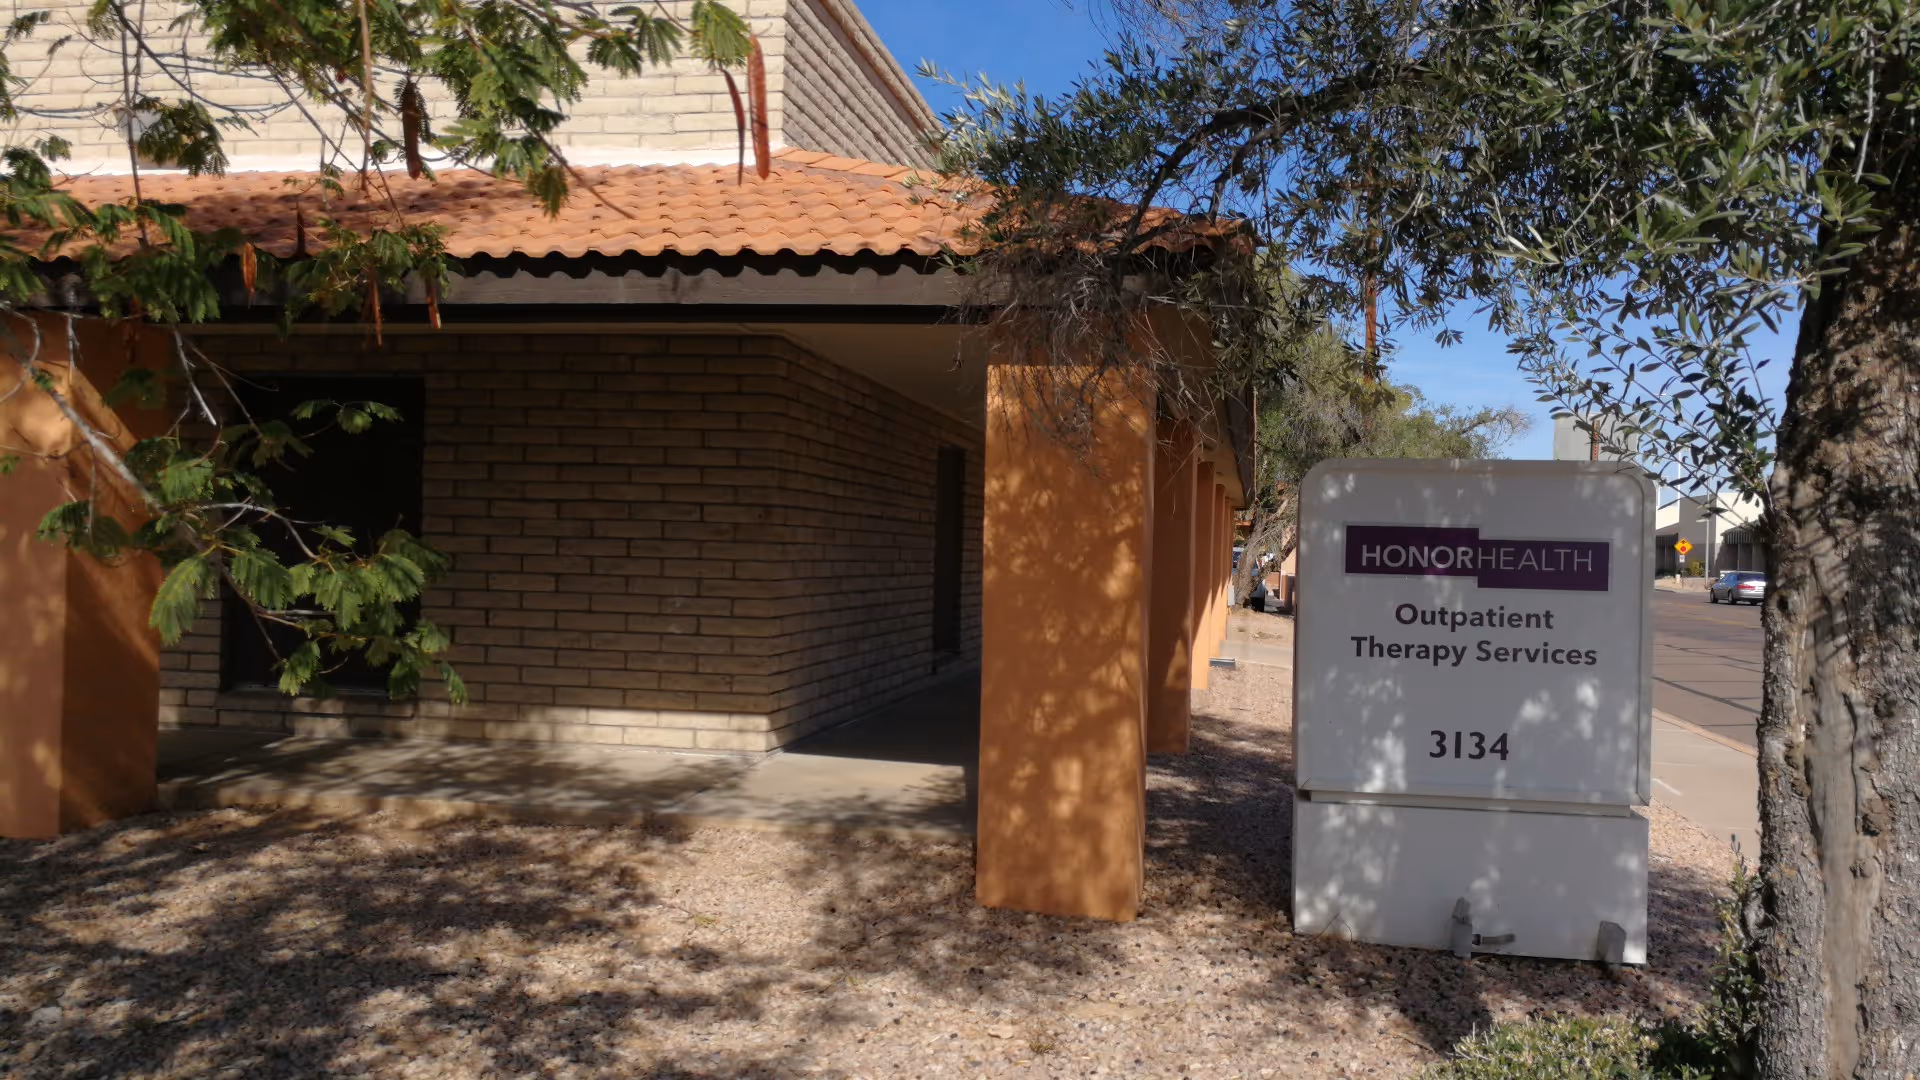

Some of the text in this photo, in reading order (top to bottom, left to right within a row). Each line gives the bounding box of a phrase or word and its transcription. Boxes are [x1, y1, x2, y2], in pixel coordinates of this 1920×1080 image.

[1361, 544, 1593, 572] HONORHEALTH
[1395, 603, 1554, 632] Outpatient
[1350, 636, 1597, 667] Therapy Services
[1429, 730, 1509, 761] 3134
